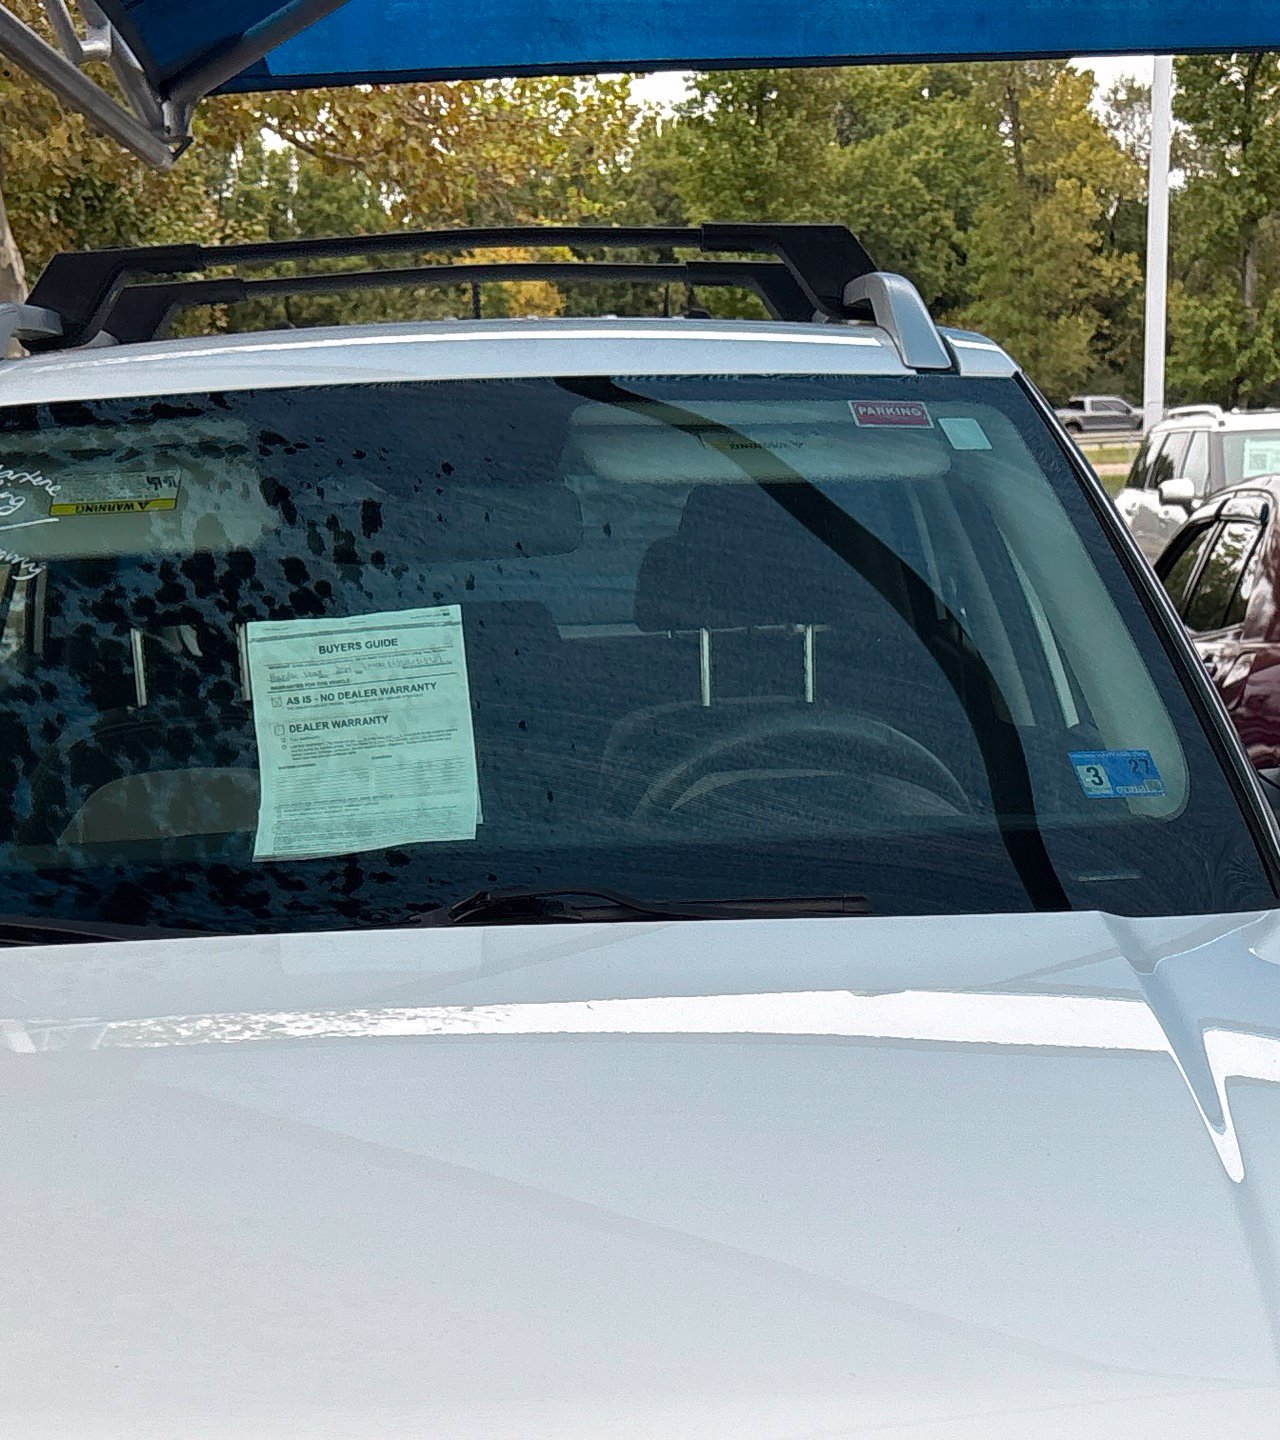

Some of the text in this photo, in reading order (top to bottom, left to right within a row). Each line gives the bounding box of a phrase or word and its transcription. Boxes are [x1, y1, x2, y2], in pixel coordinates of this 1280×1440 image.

[857, 406, 922, 416] PARKING
[75, 502, 134, 514] WARNING
[318, 641, 363, 655] BUYERS
[364, 638, 399, 649] GUIDE
[286, 696, 301, 705] AS
[302, 695, 312, 704] IS
[320, 693, 335, 702] NO
[337, 688, 378, 700] DEALER
[379, 681, 437, 696] WARRANTY
[289, 714, 389, 733] DEALER WARRANTY
[1086, 766, 1104, 786] 3
